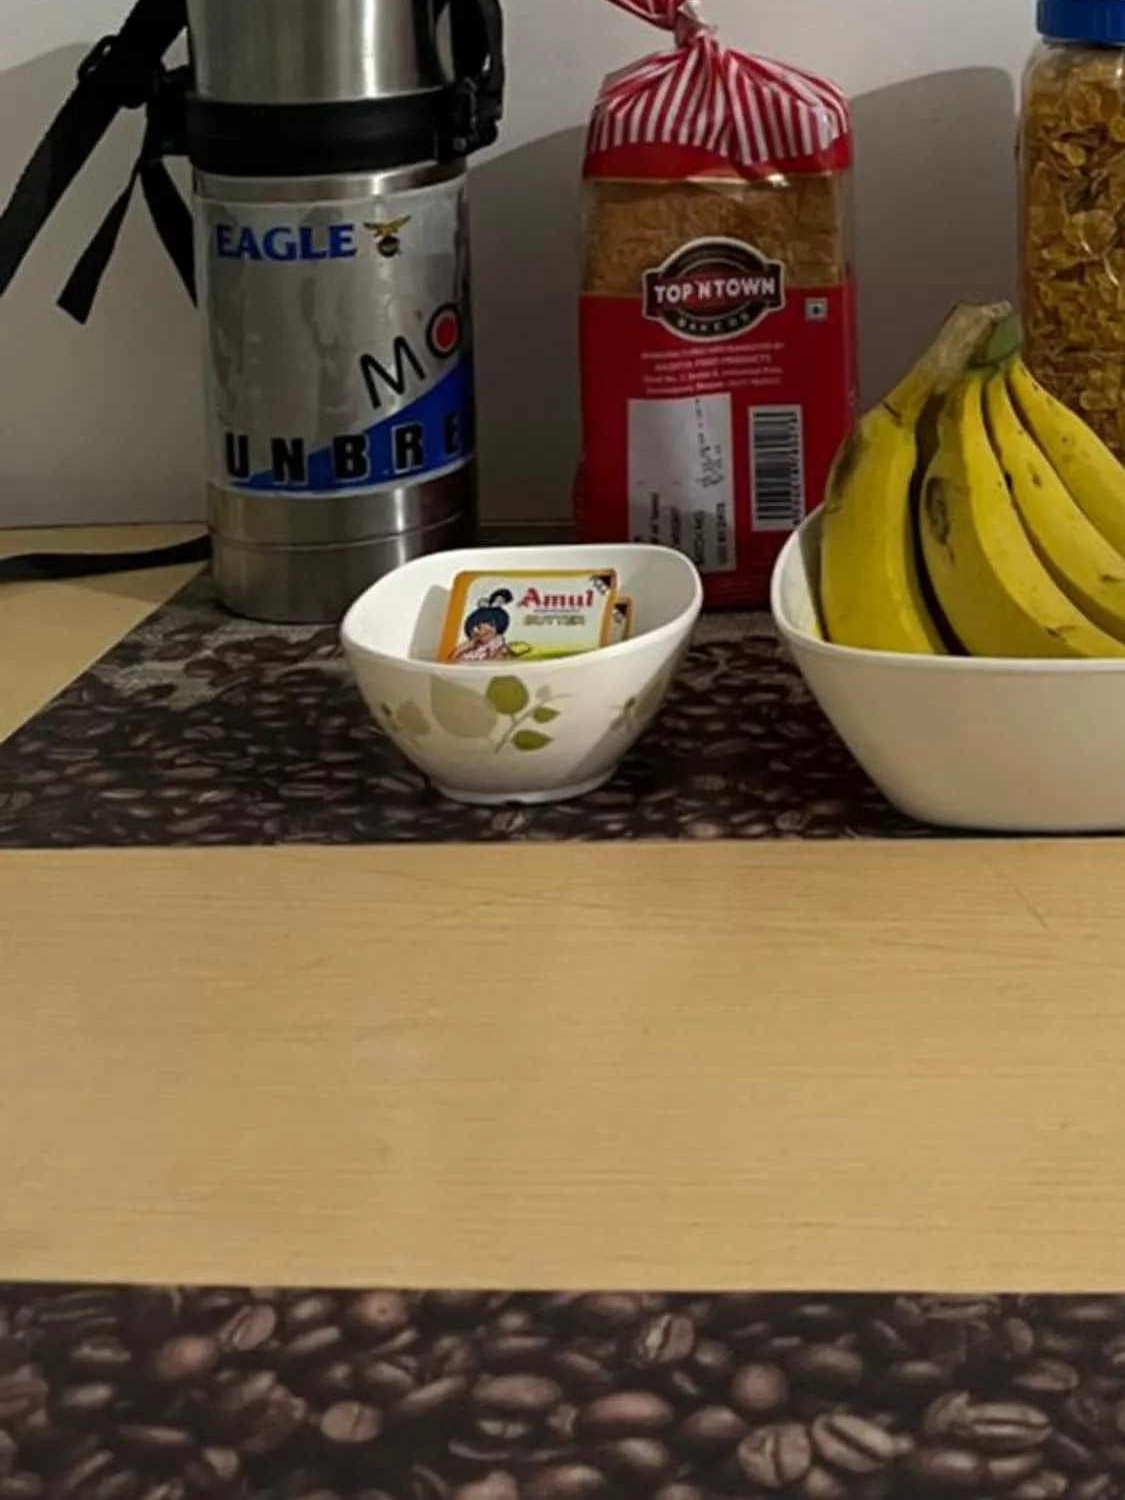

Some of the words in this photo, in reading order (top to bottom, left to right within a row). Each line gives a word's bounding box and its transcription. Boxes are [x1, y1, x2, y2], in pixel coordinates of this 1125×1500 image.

[215, 223, 357, 261] EAGLE
[653, 283, 693, 304] TOP
[712, 276, 776, 298] TOWN
[517, 587, 594, 608] Amul
